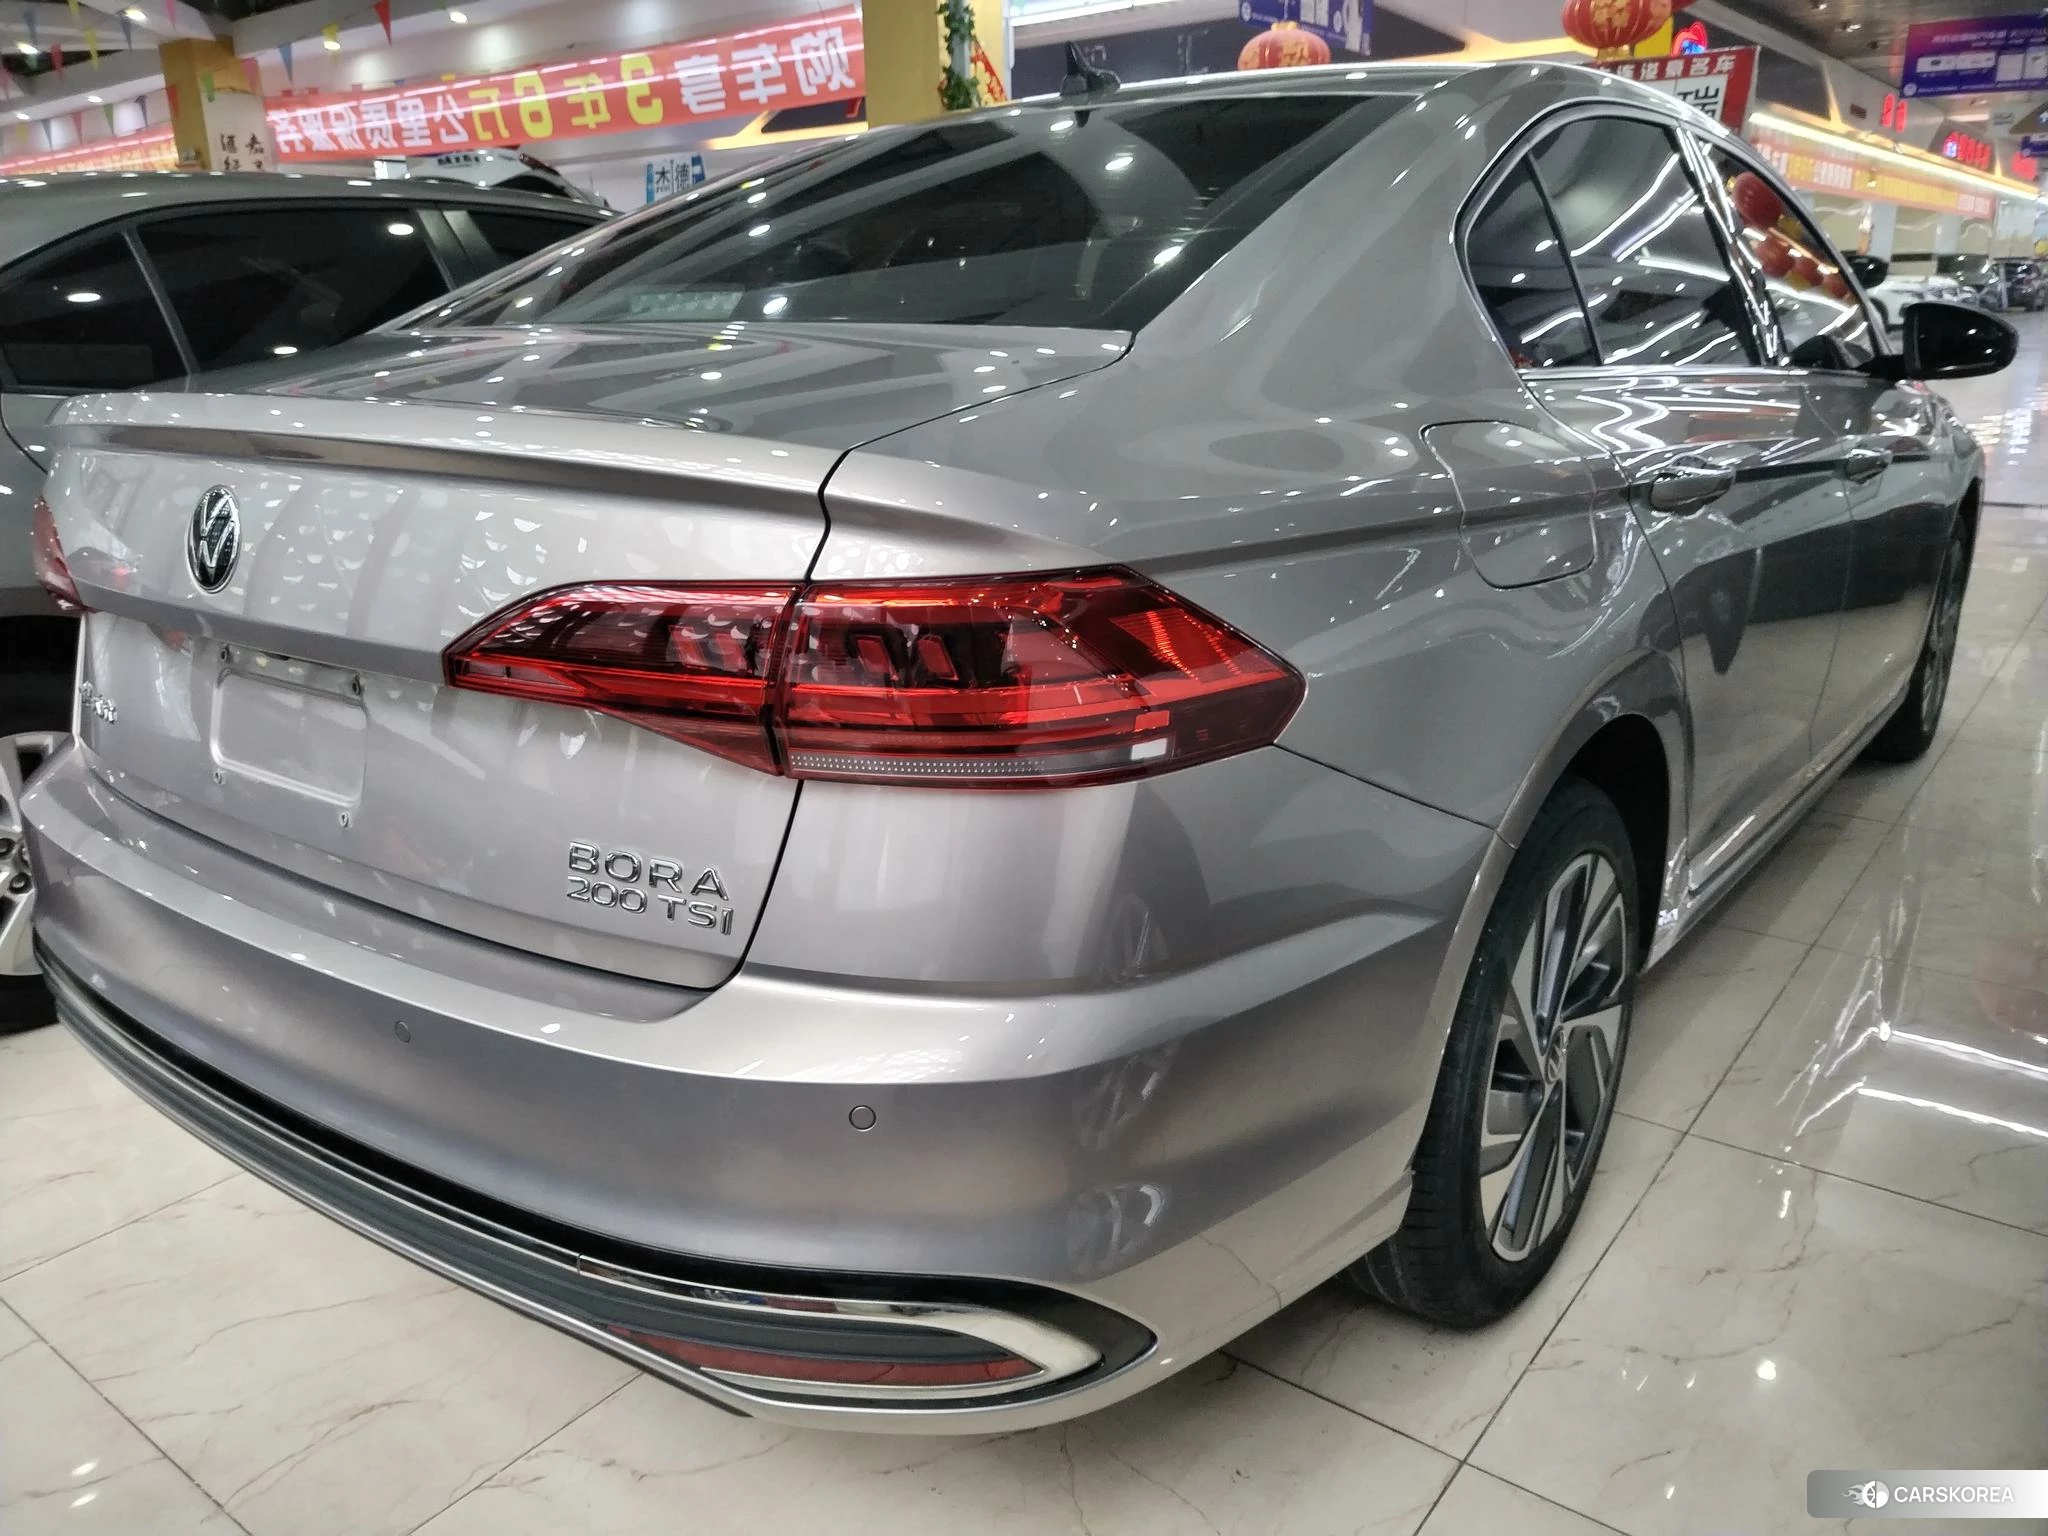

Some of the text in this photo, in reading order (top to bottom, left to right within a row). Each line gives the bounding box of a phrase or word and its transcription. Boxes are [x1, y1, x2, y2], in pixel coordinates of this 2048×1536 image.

[569, 841, 729, 901] BORA
[567, 875, 734, 935] 200 TSI
